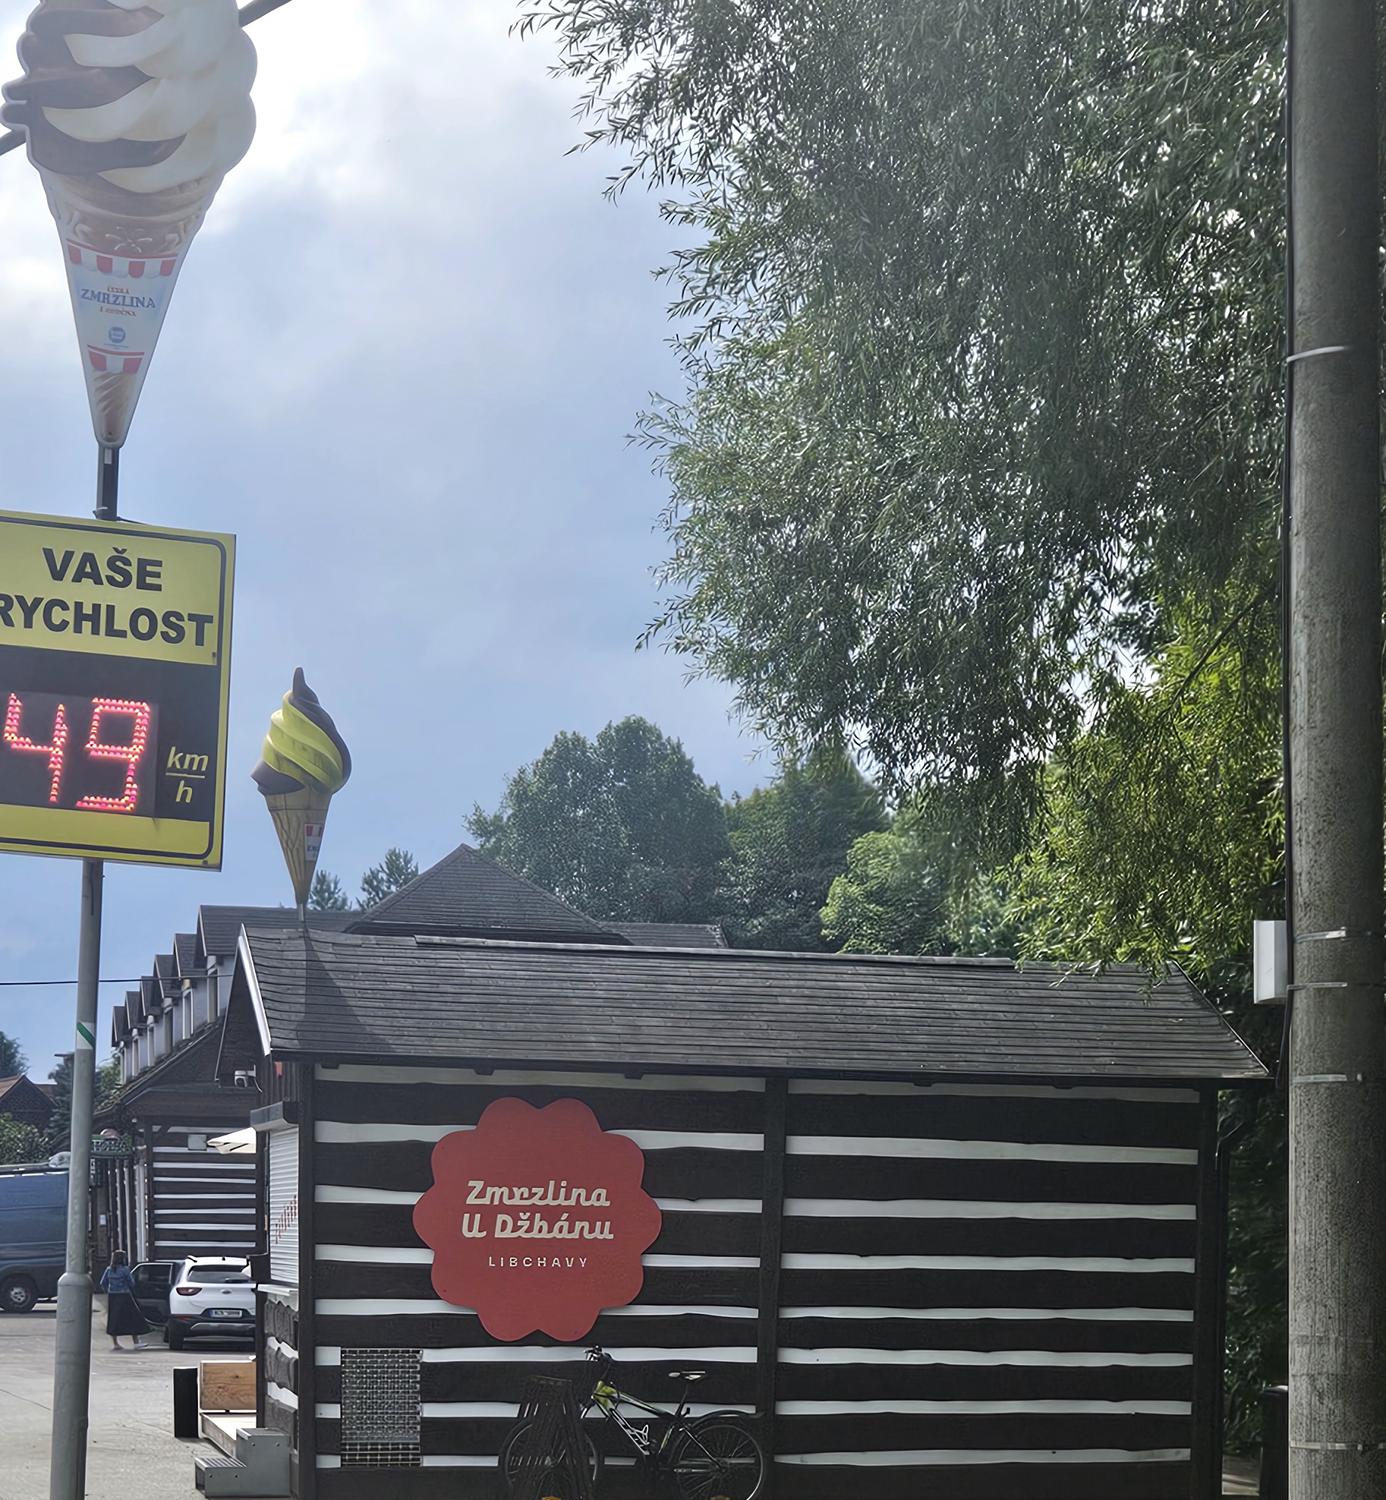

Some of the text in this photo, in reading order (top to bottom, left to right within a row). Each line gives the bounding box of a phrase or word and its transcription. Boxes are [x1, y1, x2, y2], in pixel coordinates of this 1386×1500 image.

[80, 288, 156, 308] ZMRZLINA
[42, 547, 163, 592] VAŠE
[0, 593, 214, 646] RYCHLOST
[3, 692, 151, 812] 49
[167, 746, 209, 772] km
[175, 780, 193, 804] h
[465, 1179, 611, 1207] Zmrzlina
[461, 1212, 614, 1239] U Džbánu
[488, 1256, 588, 1268] LIBCHAVY
